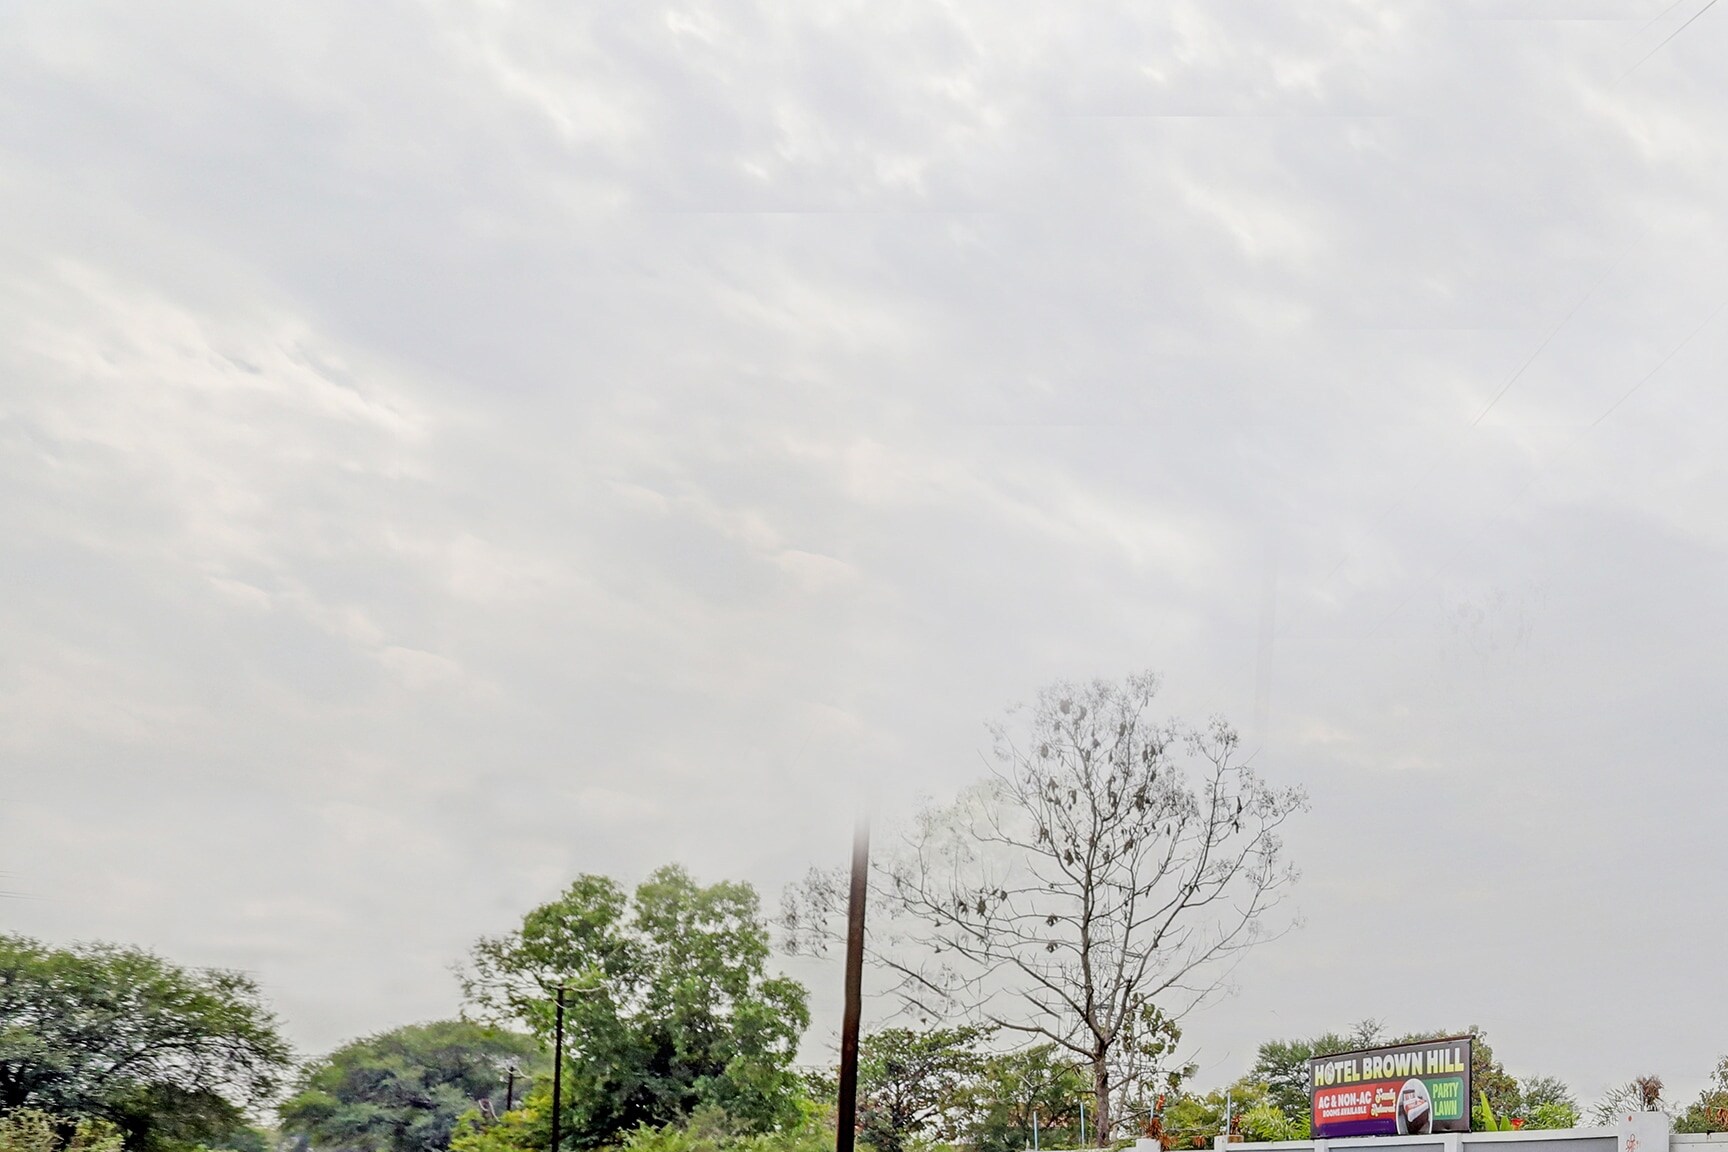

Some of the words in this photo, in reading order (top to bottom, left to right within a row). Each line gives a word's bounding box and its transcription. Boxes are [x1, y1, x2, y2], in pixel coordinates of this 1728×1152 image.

[1362, 1051, 1423, 1080] BROWN
[1427, 1047, 1465, 1074] HILL
[1318, 1095, 1330, 1109] AC
[1338, 1090, 1372, 1107] NON-AC
[1432, 1082, 1459, 1099] PARTY
[1434, 1100, 1458, 1116] LAWN
